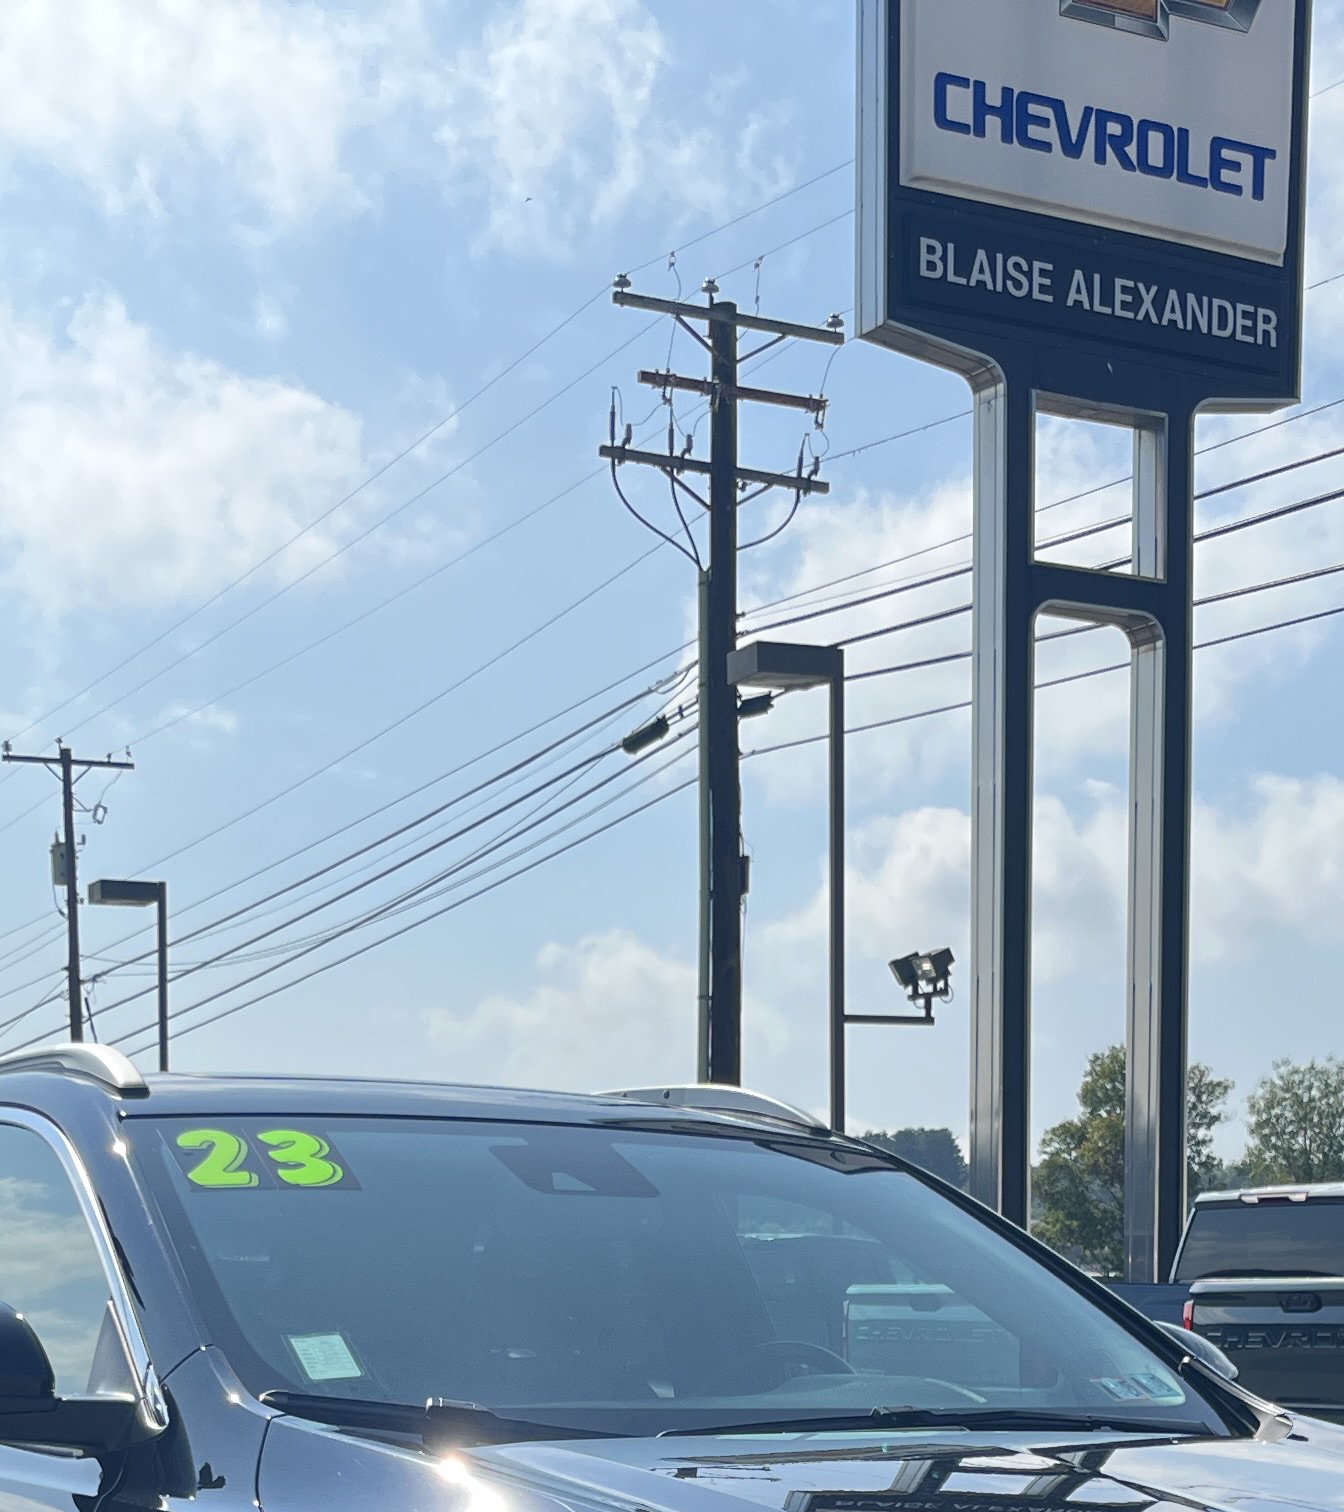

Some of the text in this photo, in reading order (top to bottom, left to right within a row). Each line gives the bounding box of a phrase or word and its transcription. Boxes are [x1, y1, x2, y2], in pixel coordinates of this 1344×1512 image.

[933, 71, 1277, 202] CHEVROLET
[918, 236, 1278, 349] BLAISE ALEXANDER
[175, 1129, 344, 1189] 23
